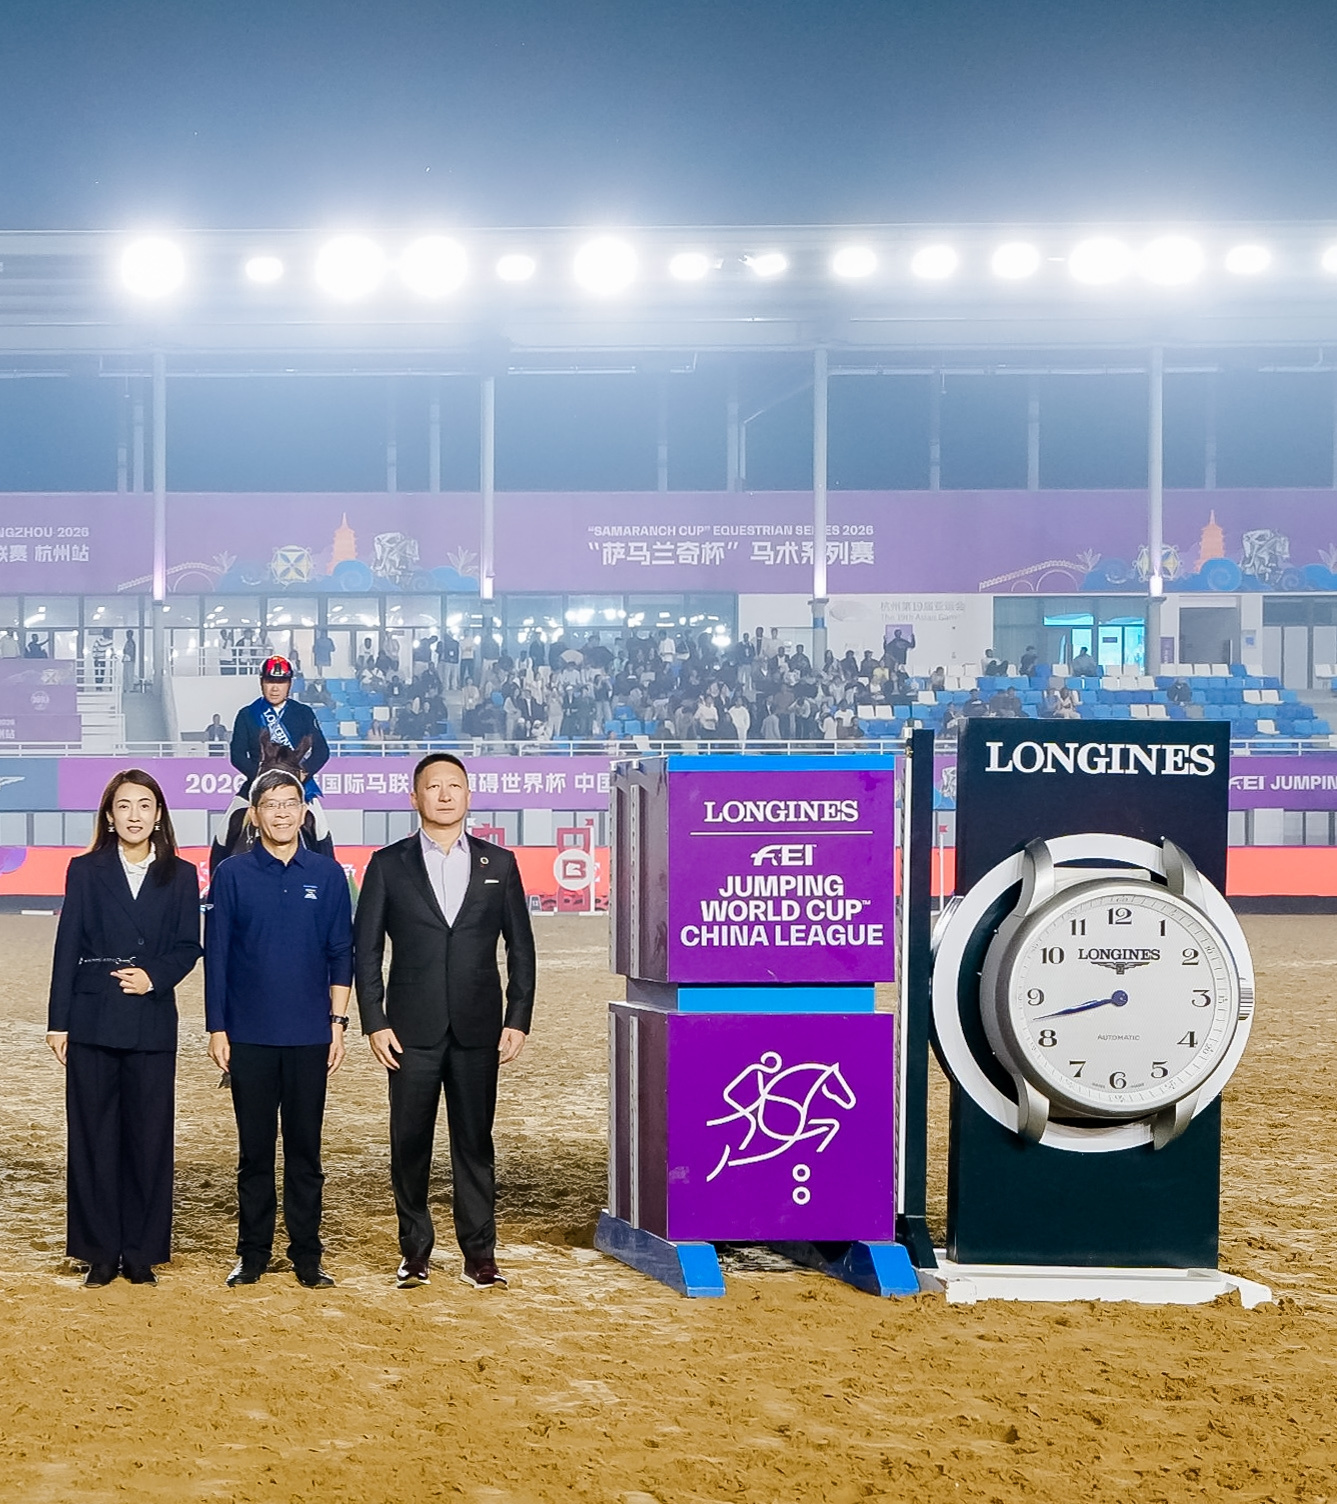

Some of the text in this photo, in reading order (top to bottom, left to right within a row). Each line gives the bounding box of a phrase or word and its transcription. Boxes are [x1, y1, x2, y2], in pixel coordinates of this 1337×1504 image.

[56, 527, 89, 538] 2026
[713, 525, 793, 536] EQUESTRIAN
[795, 525, 840, 536] SEES
[842, 525, 874, 536] 2026
[34, 544, 89, 562] 杭州站
[985, 741, 1216, 776] LONGINES
[185, 773, 248, 794] 2026
[1270, 775, 1337, 790] JUMPIN
[704, 800, 859, 823] LONGINES
[750, 844, 817, 866] FEI
[718, 875, 844, 897] JUMPING
[700, 900, 801, 922] WORLD
[1107, 908, 1132, 925] 12
[680, 924, 884, 946] CHINA LEAGUE
[1069, 918, 1086, 936] 11
[1159, 919, 1166, 936] 1
[1040, 946, 1065, 964] 10
[1078, 948, 1161, 960] LONGINES
[1182, 948, 1199, 965] 2
[1027, 988, 1045, 1006] 9
[1191, 989, 1211, 1008] 3
[1038, 1029, 1058, 1047] 8
[1176, 1030, 1199, 1048] 4
[1069, 1060, 1086, 1078] 7
[1151, 1060, 1169, 1079] 5
[1109, 1071, 1127, 1089] 6
